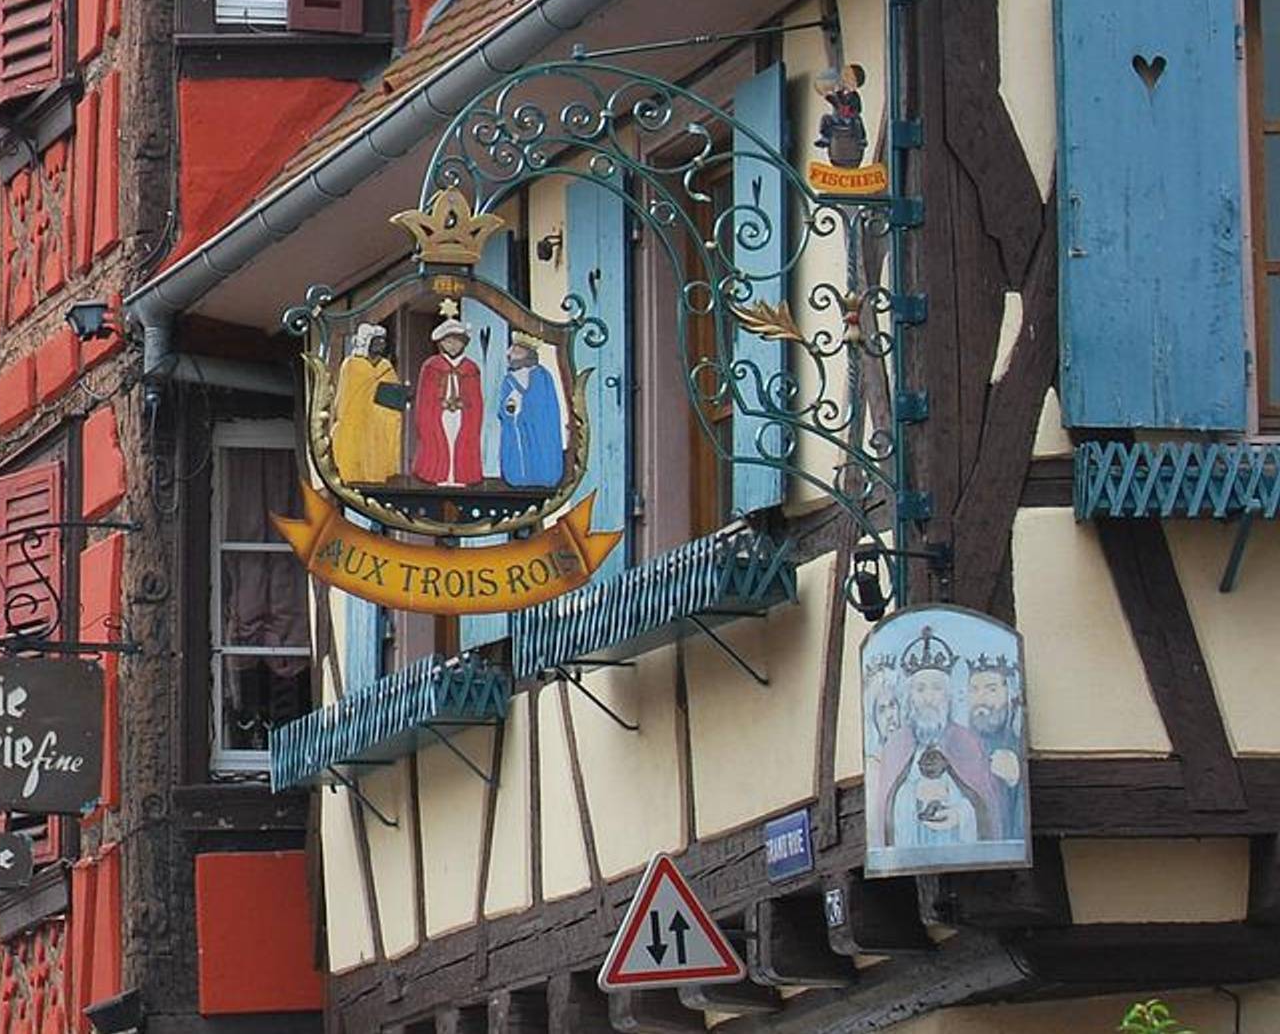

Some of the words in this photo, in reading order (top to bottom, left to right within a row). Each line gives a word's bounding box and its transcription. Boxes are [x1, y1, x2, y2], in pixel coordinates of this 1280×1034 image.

[809, 170, 885, 188] FISCHER
[315, 538, 390, 586] AUX
[399, 564, 499, 599] TROIS
[506, 547, 581, 598] ROIS
[21, 730, 84, 798] fine
